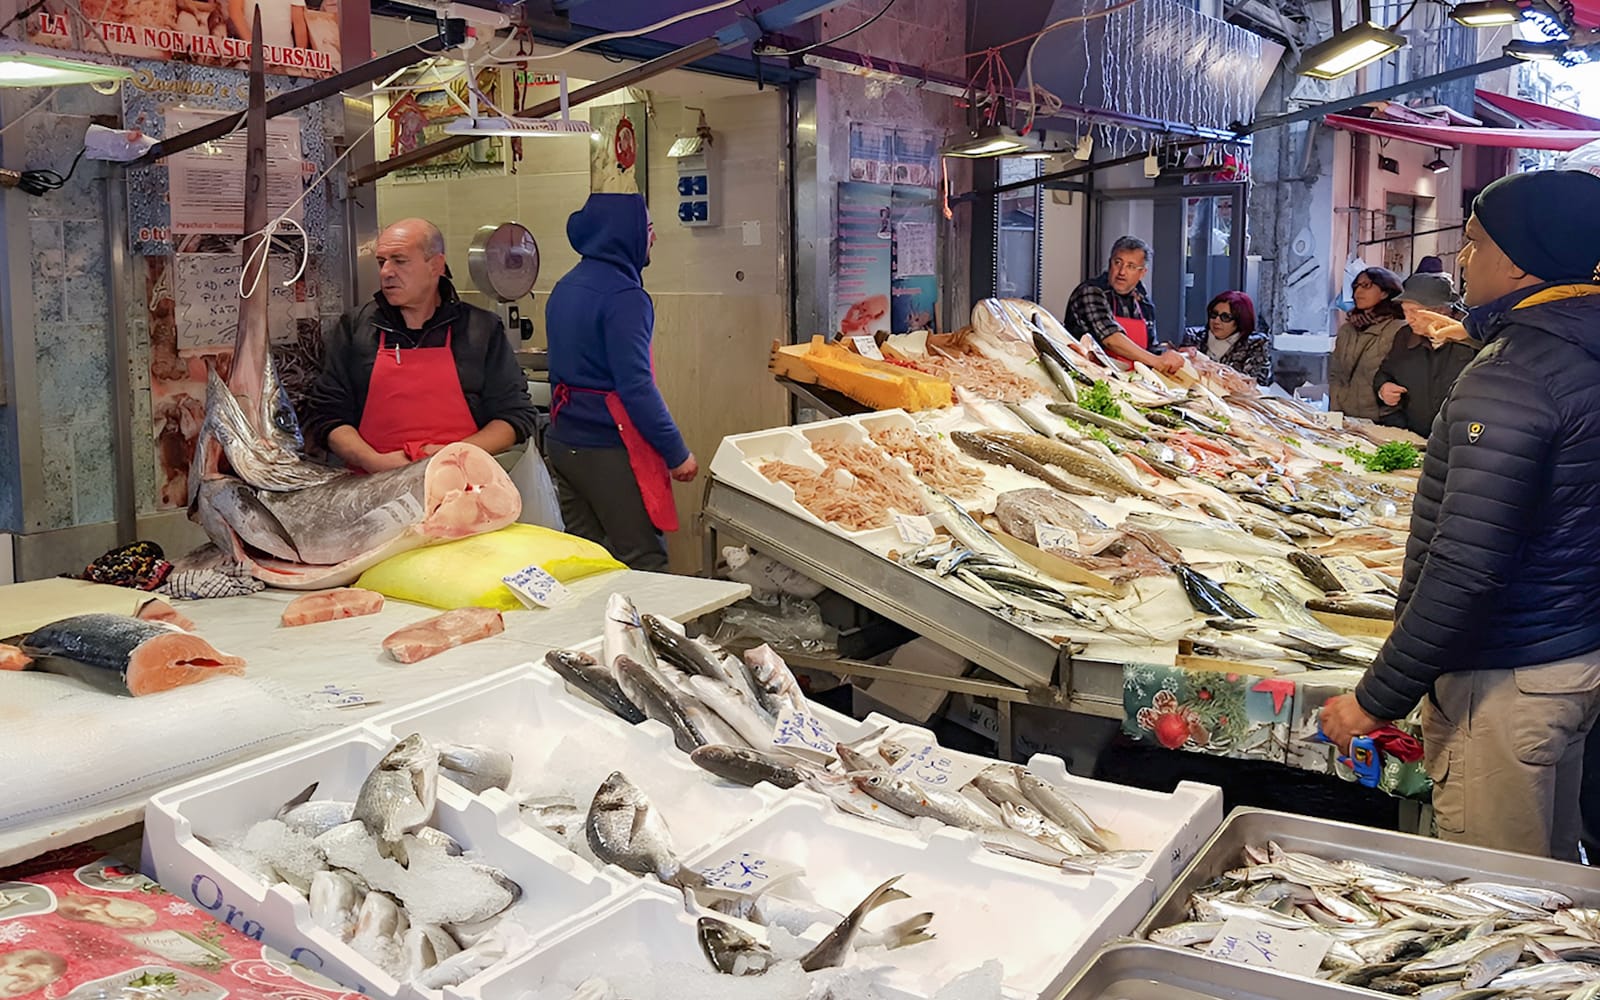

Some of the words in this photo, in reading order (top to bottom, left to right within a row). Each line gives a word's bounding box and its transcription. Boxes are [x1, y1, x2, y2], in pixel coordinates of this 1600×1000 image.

[39, 13, 68, 36] LA
[143, 27, 187, 52] NON
[191, 34, 219, 56] HA
